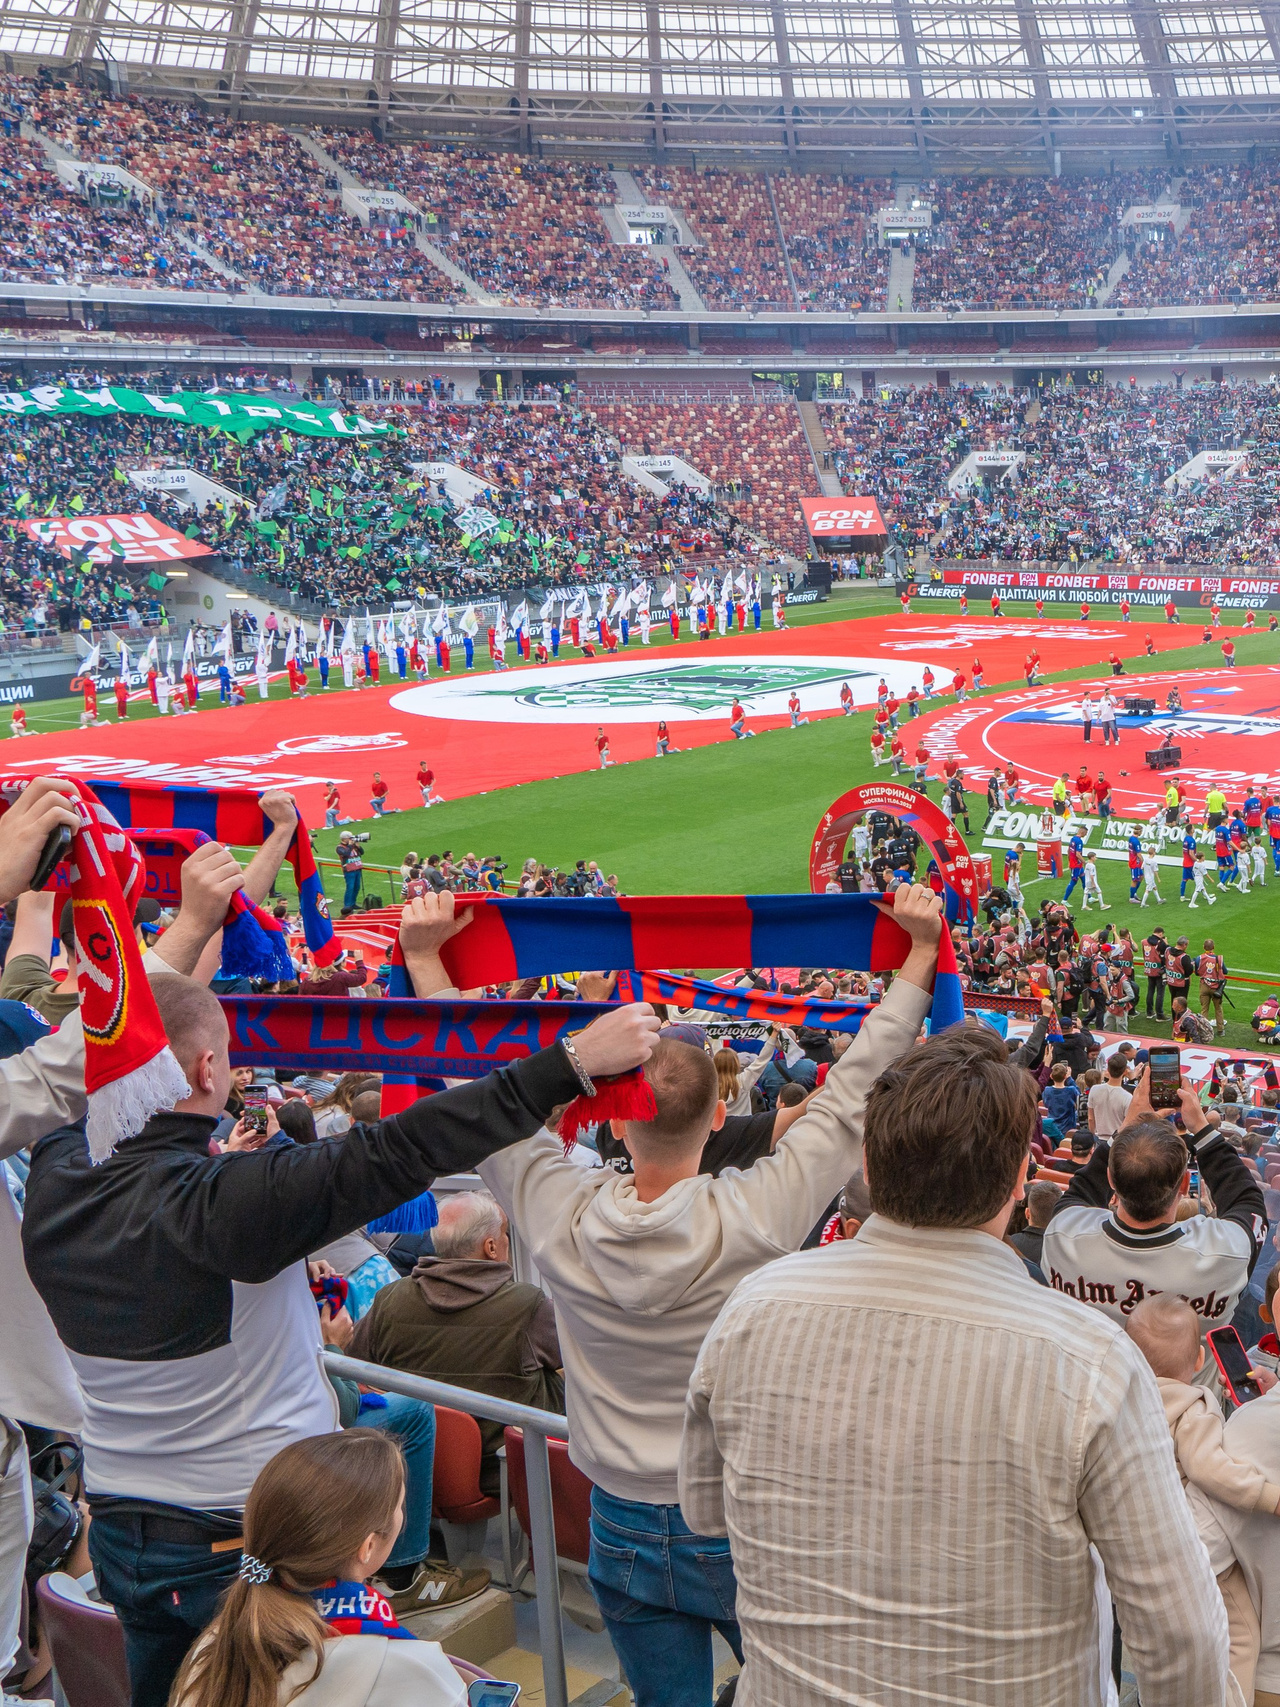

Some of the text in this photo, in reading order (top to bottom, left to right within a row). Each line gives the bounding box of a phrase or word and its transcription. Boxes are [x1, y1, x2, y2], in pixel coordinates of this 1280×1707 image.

[100, 171, 116, 181] 257
[381, 197, 395, 206] 255
[627, 211, 641, 219] 254
[983, 455, 996, 463] 144
[433, 466, 446, 475] 147
[170, 475, 187, 484] 149
[811, 509, 874, 521] FON
[813, 519, 878, 531] BET
[962, 572, 1015, 586] FONBET
[1046, 574, 1100, 588] FONBET
[1110, 576, 1127, 584] FON
[1138, 578, 1195, 591] FONBET
[1202, 578, 1220, 586] FON
[992, 588, 1172, 606] АДАПТАЦИЯ К ЛЮБОЙ СИТУАЦИИ
[5, 755, 353, 792] FONBET
[859, 787, 917, 804] СУПЕРФИНАЛ
[863, 797, 885, 806] МОСКВА
[956, 861, 969, 869] BET
[309, 1003, 543, 1055] ЦСКА
[1050, 1266, 1117, 1307] Palm
